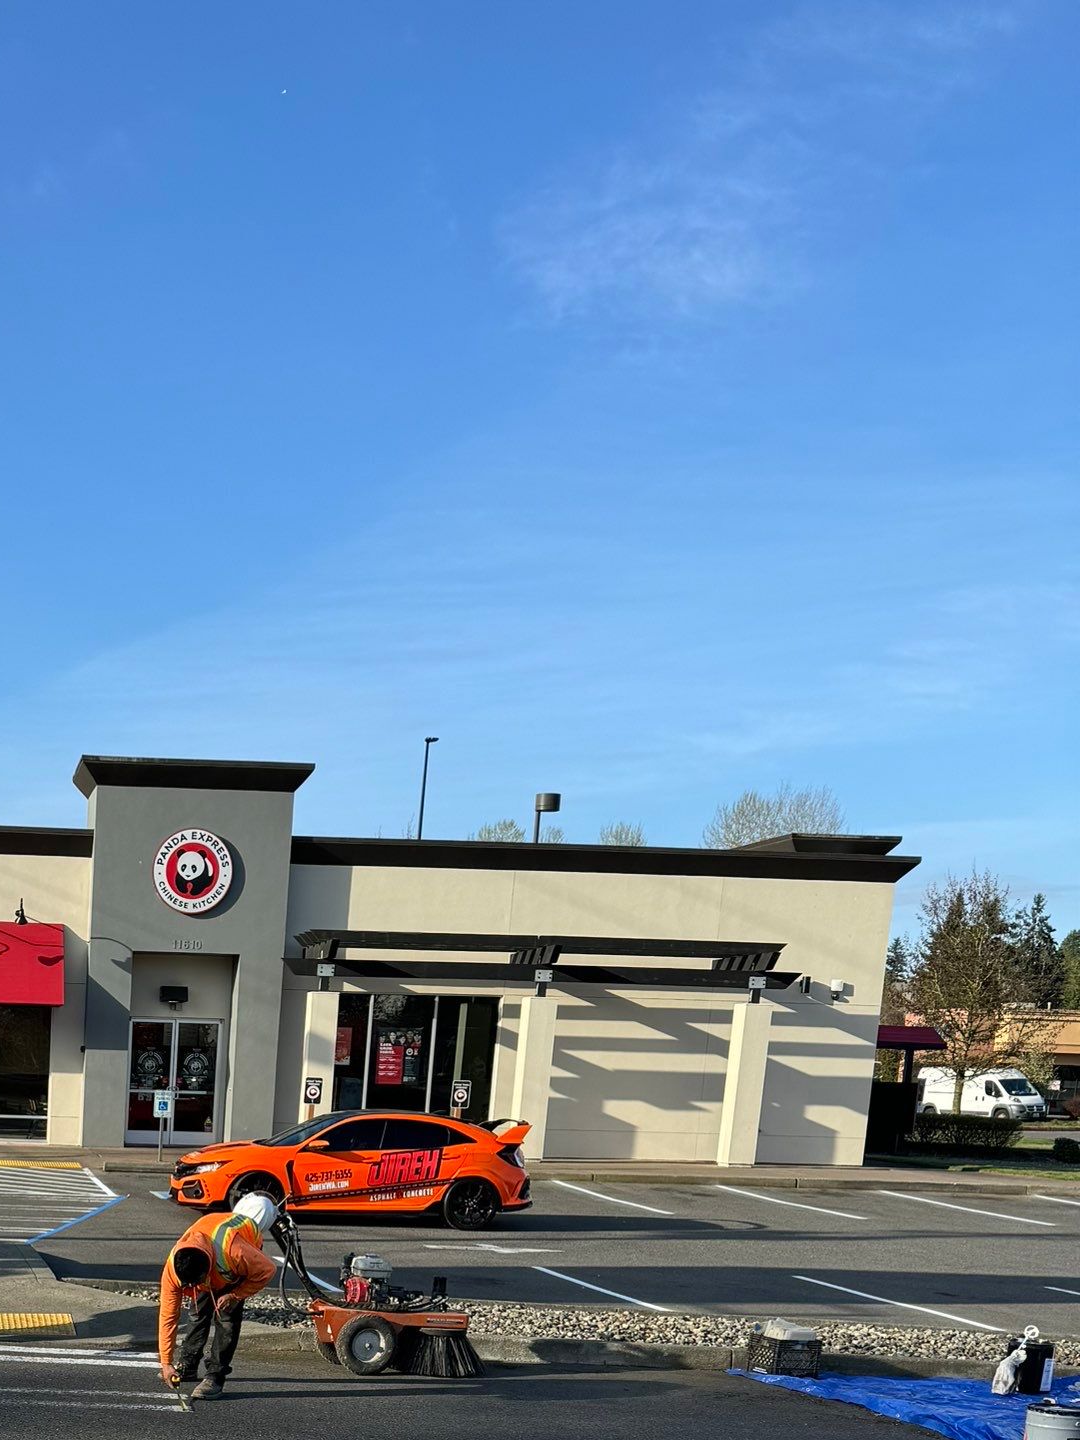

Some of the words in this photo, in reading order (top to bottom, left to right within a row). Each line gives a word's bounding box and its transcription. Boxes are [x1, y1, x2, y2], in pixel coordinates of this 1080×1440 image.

[157, 833, 188, 865] PANDA
[191, 832, 229, 867] EXPRESS
[159, 881, 189, 909] CHINESE
[192, 883, 226, 909] KITCHEN
[173, 940, 202, 949] 11610
[304, 1169, 352, 1182] 425-737-6355
[367, 1149, 441, 1186] JIREH
[370, 1192, 396, 1201] ASPHALT
[403, 1188, 433, 1198] CONCRETE
